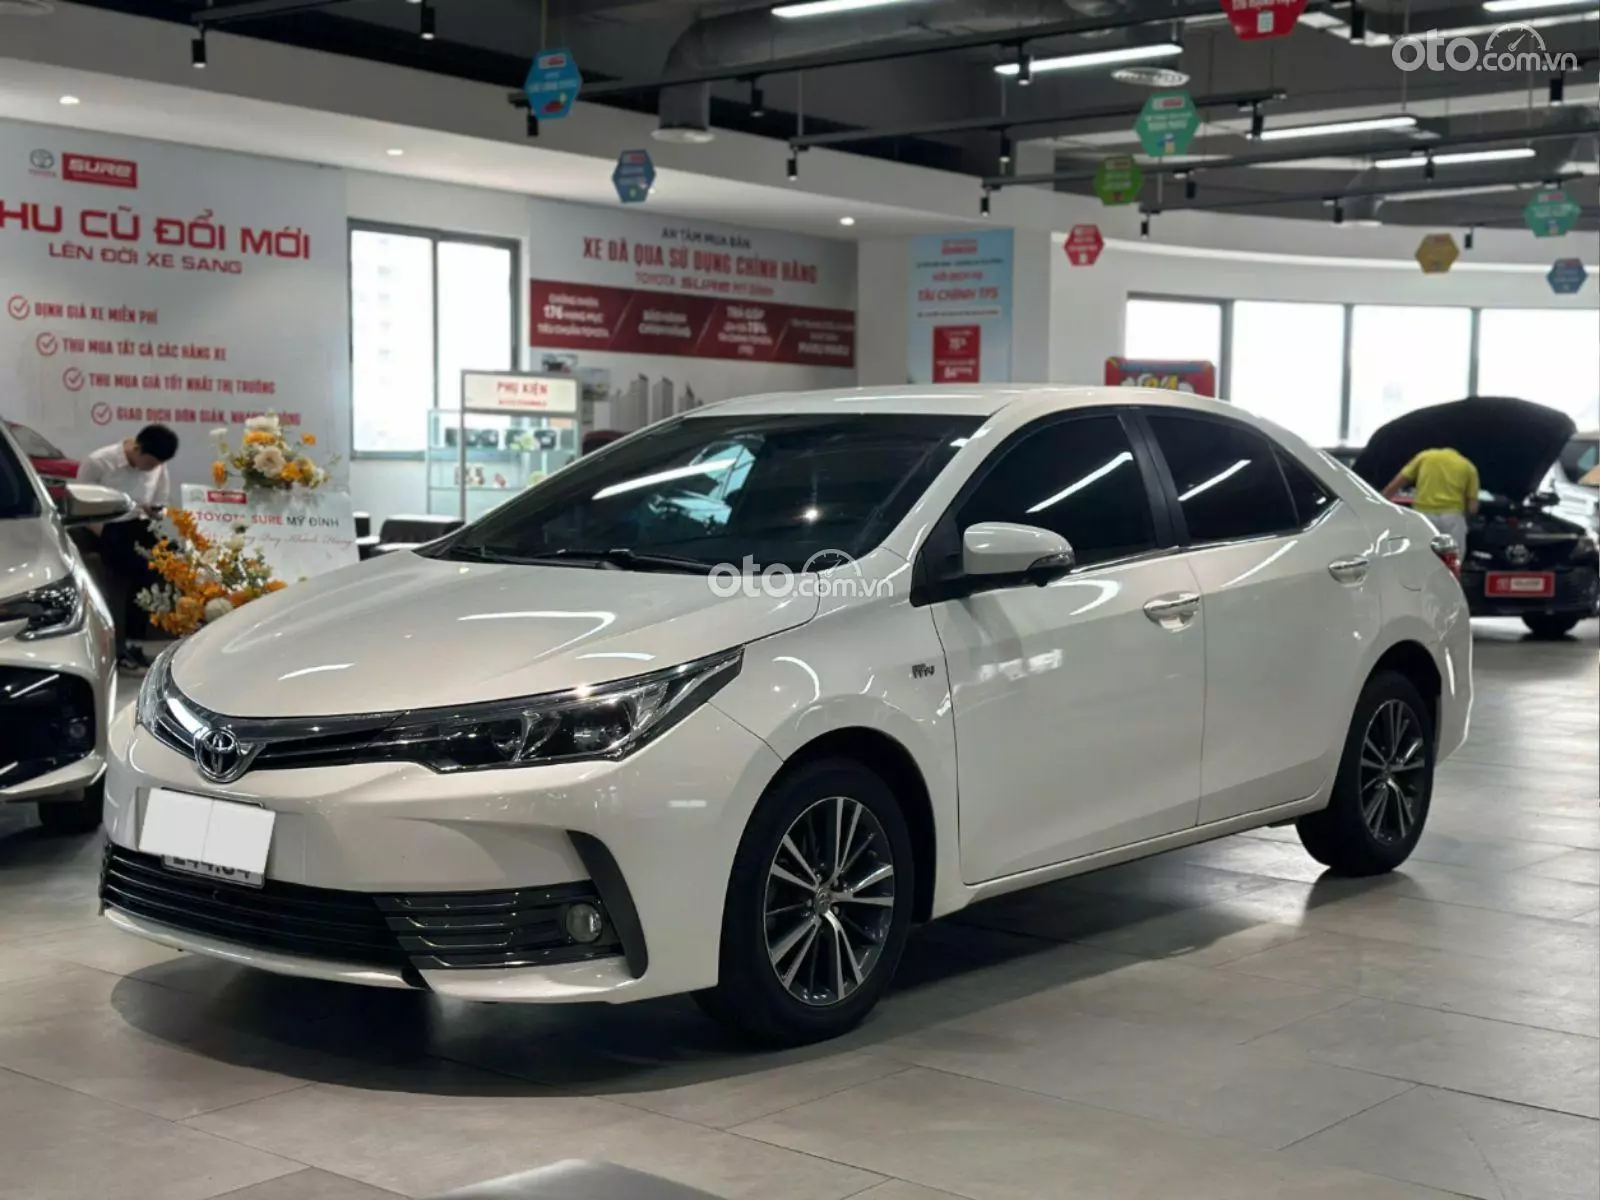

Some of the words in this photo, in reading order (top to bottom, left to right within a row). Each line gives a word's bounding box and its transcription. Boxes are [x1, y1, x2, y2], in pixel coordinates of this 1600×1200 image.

[68, 158, 132, 178] SURE
[80, 205, 140, 241] CŨ
[153, 208, 226, 251] ĐỔI
[240, 226, 310, 260] MỚI
[48, 241, 94, 261] LÊN
[100, 247, 139, 266] ĐỜI
[146, 252, 175, 269] XE
[181, 255, 243, 275] SANG
[583, 235, 603, 260] XE
[634, 243, 664, 267] QUA
[693, 250, 732, 275] DỤNG
[736, 253, 779, 280] CHÍNH
[91, 306, 104, 321] XE
[63, 337, 85, 353] THU
[88, 339, 114, 355] MUA
[213, 347, 226, 362] XE
[90, 372, 110, 388] THU
[115, 374, 138, 389] MUA
[117, 406, 143, 421] GIAO
[251, 514, 284, 526] SURE
